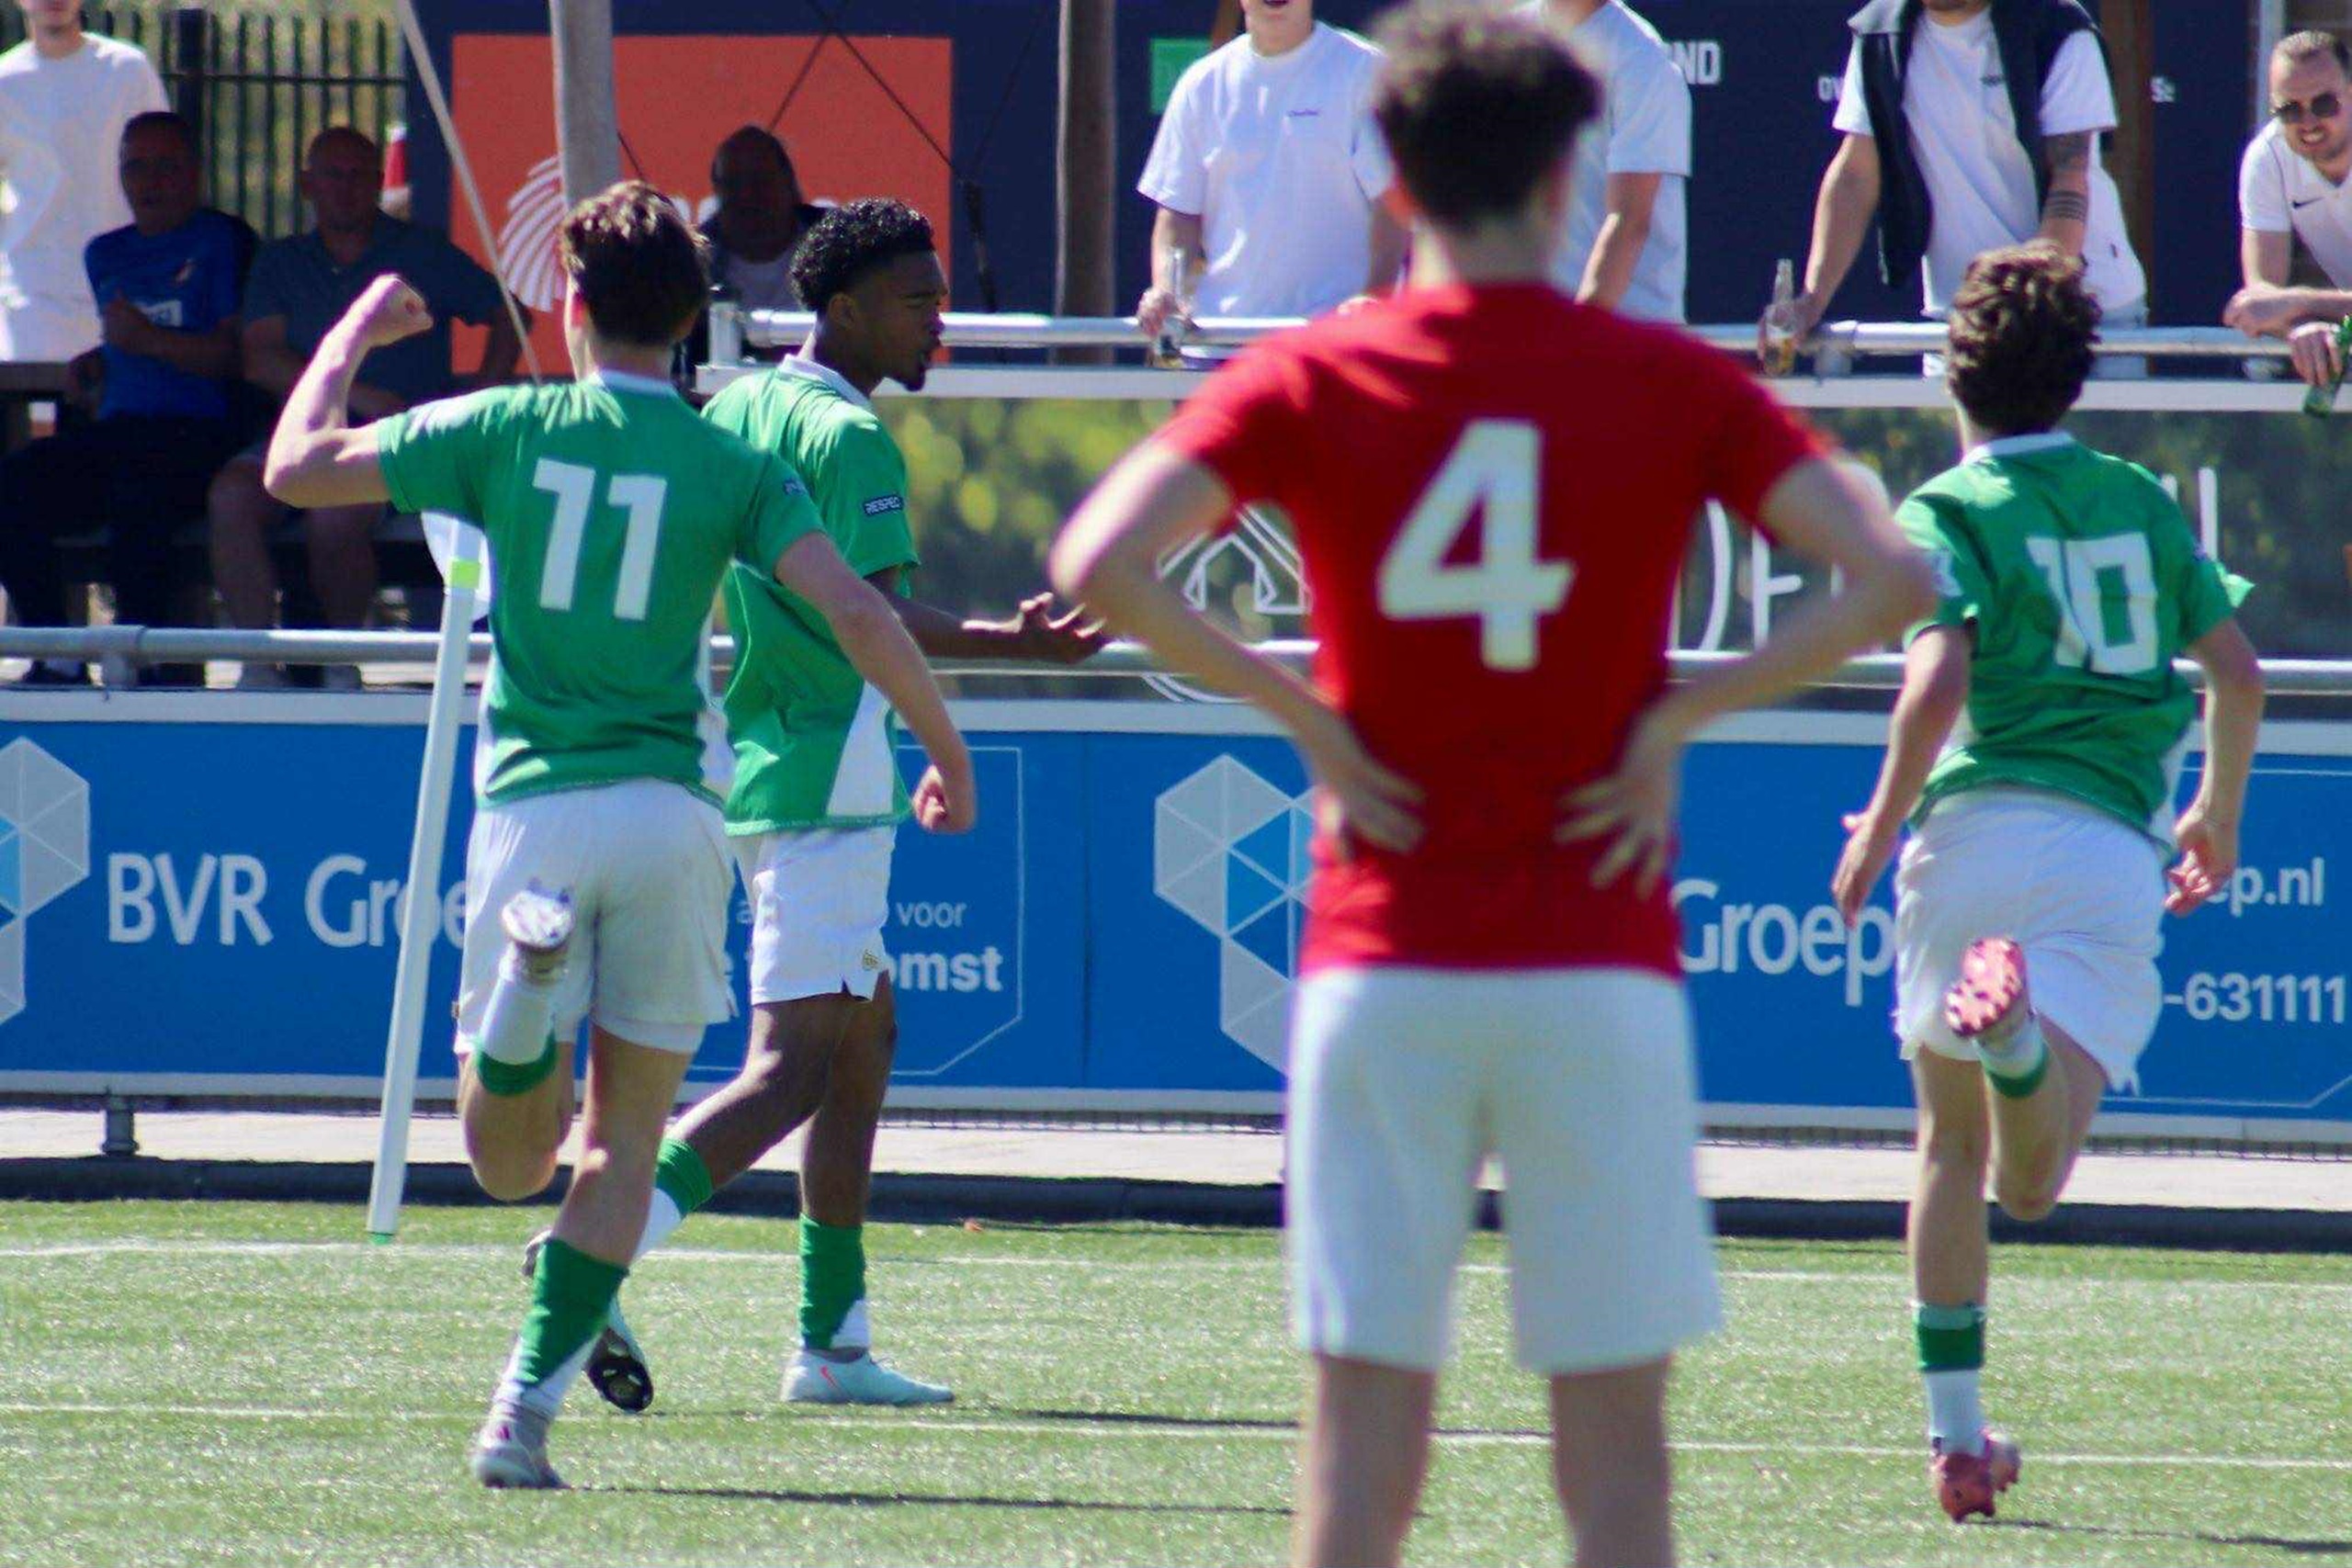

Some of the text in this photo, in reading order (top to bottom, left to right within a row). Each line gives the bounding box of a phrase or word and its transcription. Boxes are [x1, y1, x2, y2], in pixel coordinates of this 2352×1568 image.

[532, 457, 668, 622] 11
[1378, 418, 1577, 671] 4
[2025, 531, 2159, 674] 10
[107, 852, 275, 947] BVR
[896, 902, 967, 929] voor
[2208, 856, 2325, 918] p.nl
[888, 944, 1005, 992] mst
[1669, 878, 1897, 1008] Groep
[2163, 971, 2346, 1033] -631111
